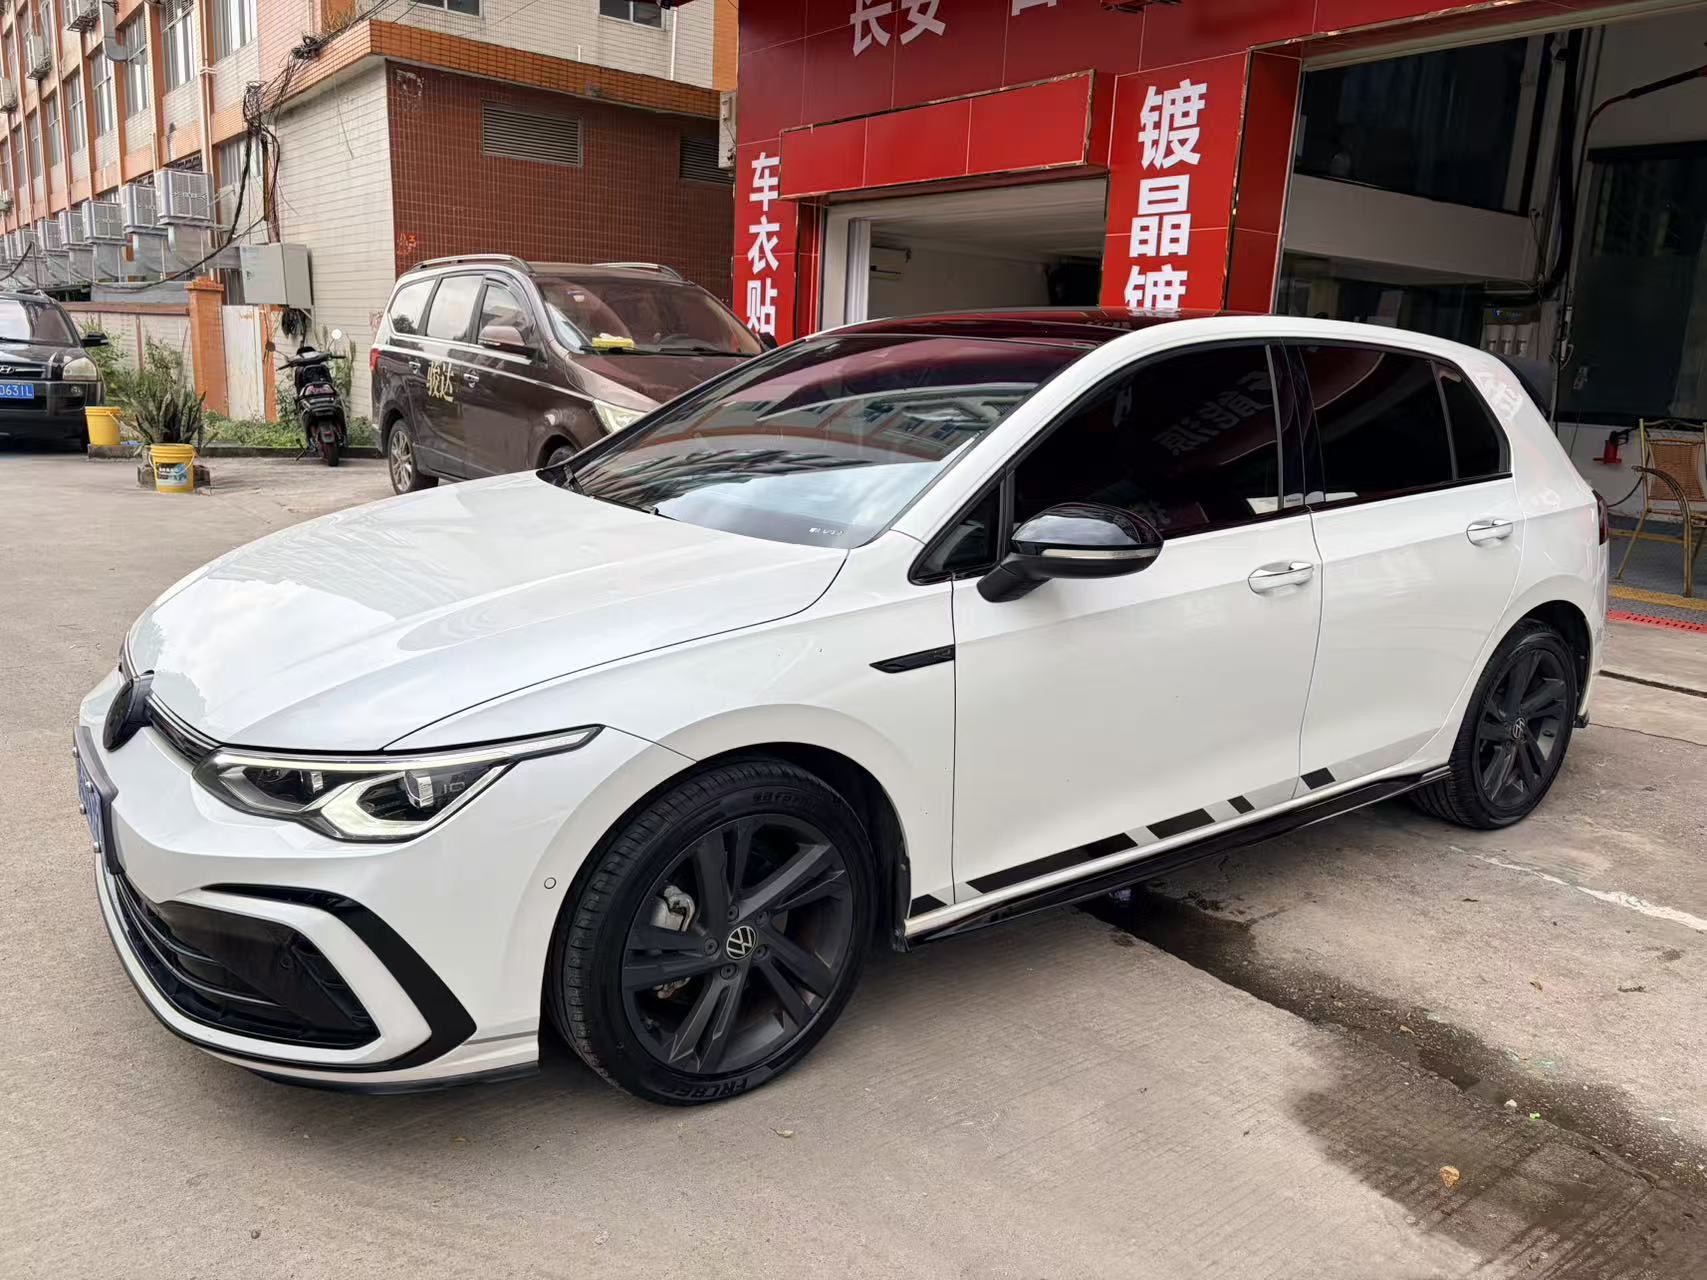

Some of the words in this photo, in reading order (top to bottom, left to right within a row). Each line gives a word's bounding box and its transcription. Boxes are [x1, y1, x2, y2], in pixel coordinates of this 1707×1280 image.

[747, 152, 781, 337] 车衣贴
[426, 361, 455, 403] 骏达
